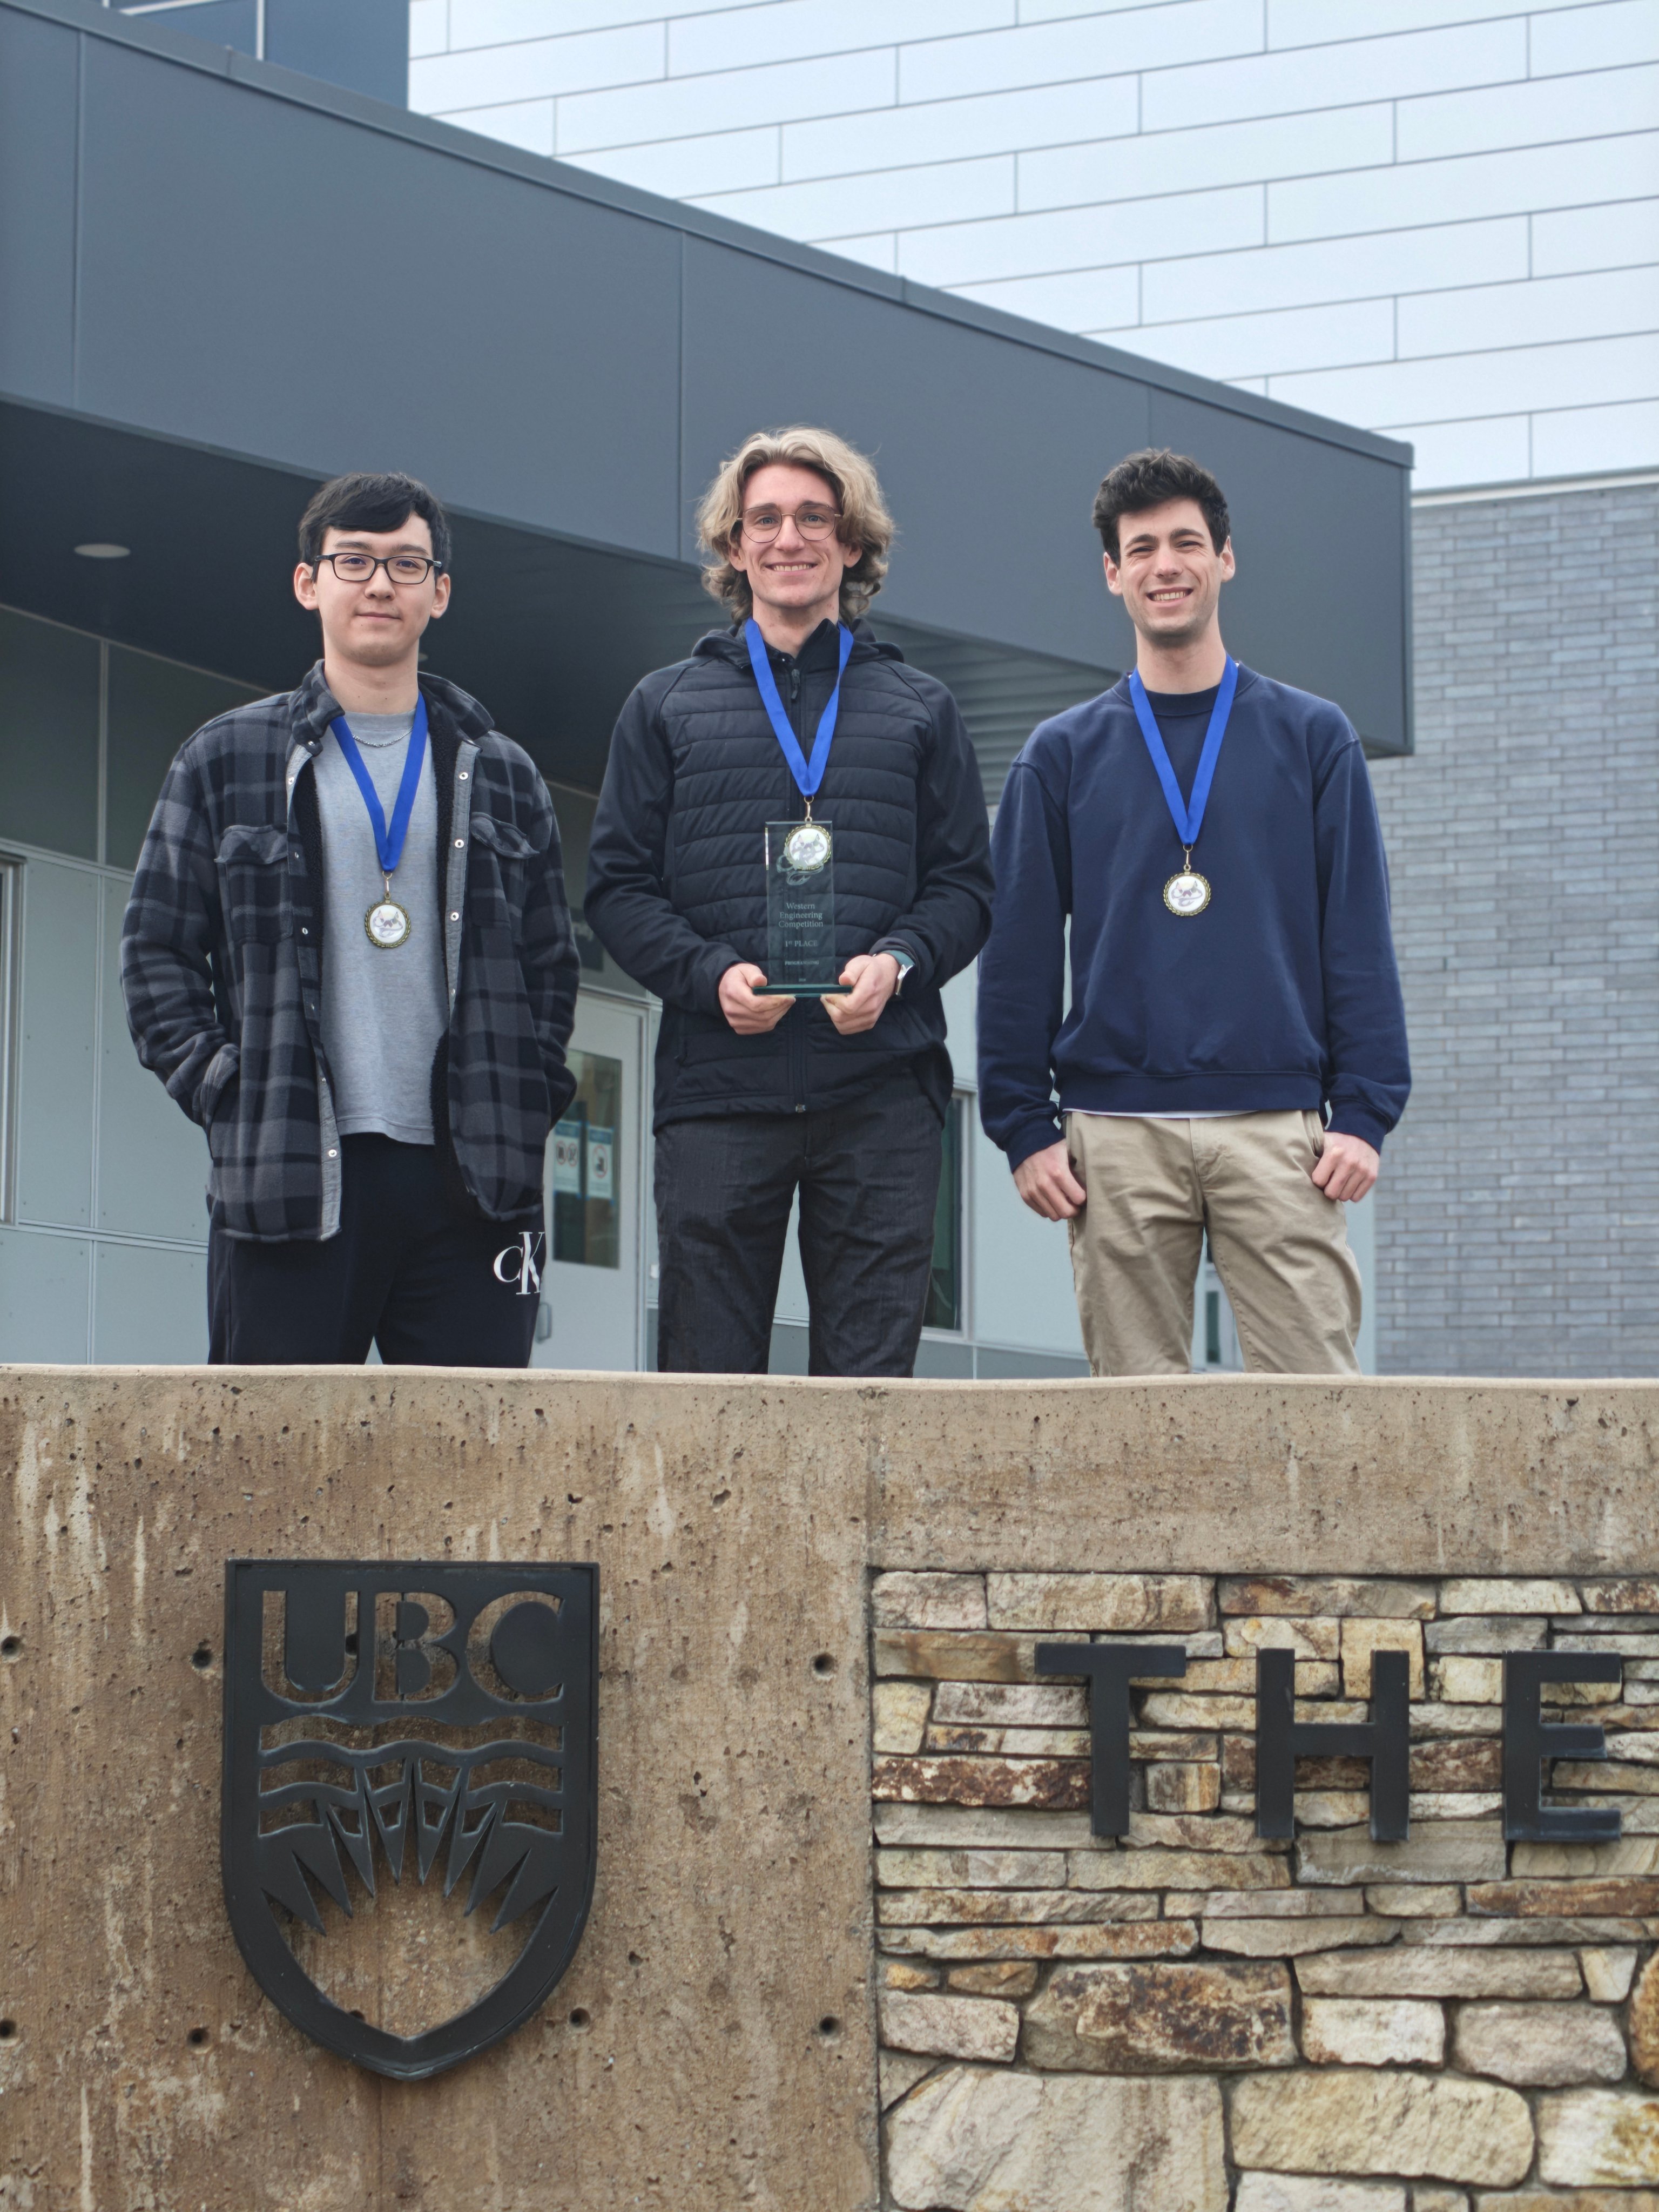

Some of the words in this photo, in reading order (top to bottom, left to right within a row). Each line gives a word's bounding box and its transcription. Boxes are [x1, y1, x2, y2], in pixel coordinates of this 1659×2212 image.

[778, 920, 823, 929] Competition
[779, 911, 822, 920] Engineering
[261, 1590, 564, 1705] UBC
[1035, 1642, 1622, 1842] THE
